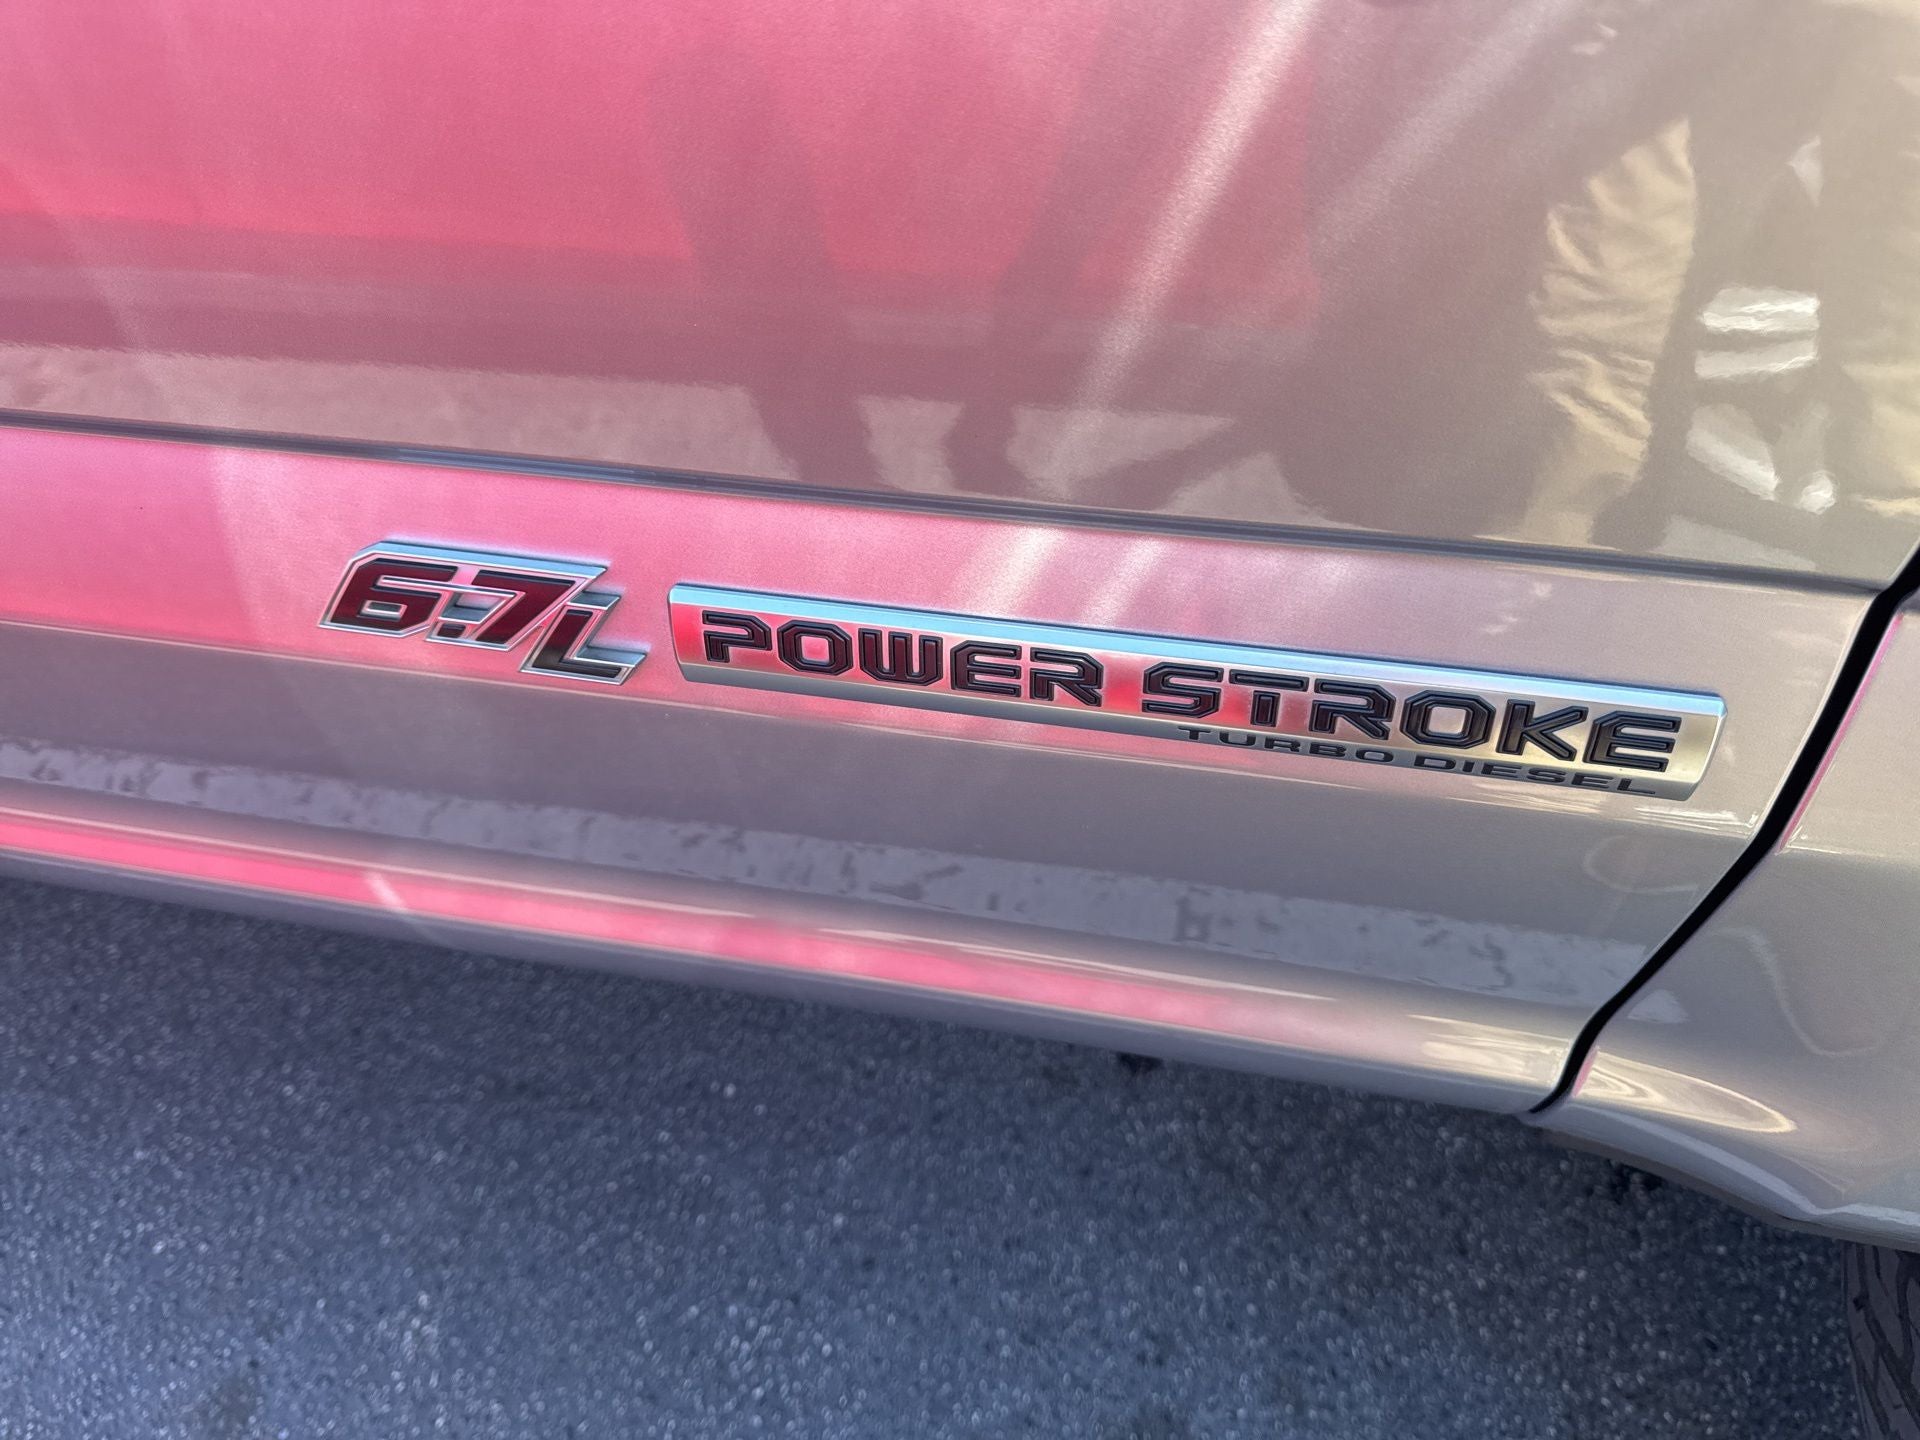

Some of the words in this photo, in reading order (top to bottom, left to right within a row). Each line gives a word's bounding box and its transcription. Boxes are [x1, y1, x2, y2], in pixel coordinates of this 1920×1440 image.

[322, 549, 642, 684] 6.7L
[702, 609, 1105, 707] POWER
[1141, 661, 1682, 772] STROKE
[1177, 726, 1395, 763] TURBO
[1413, 753, 1656, 795] DIESEL
